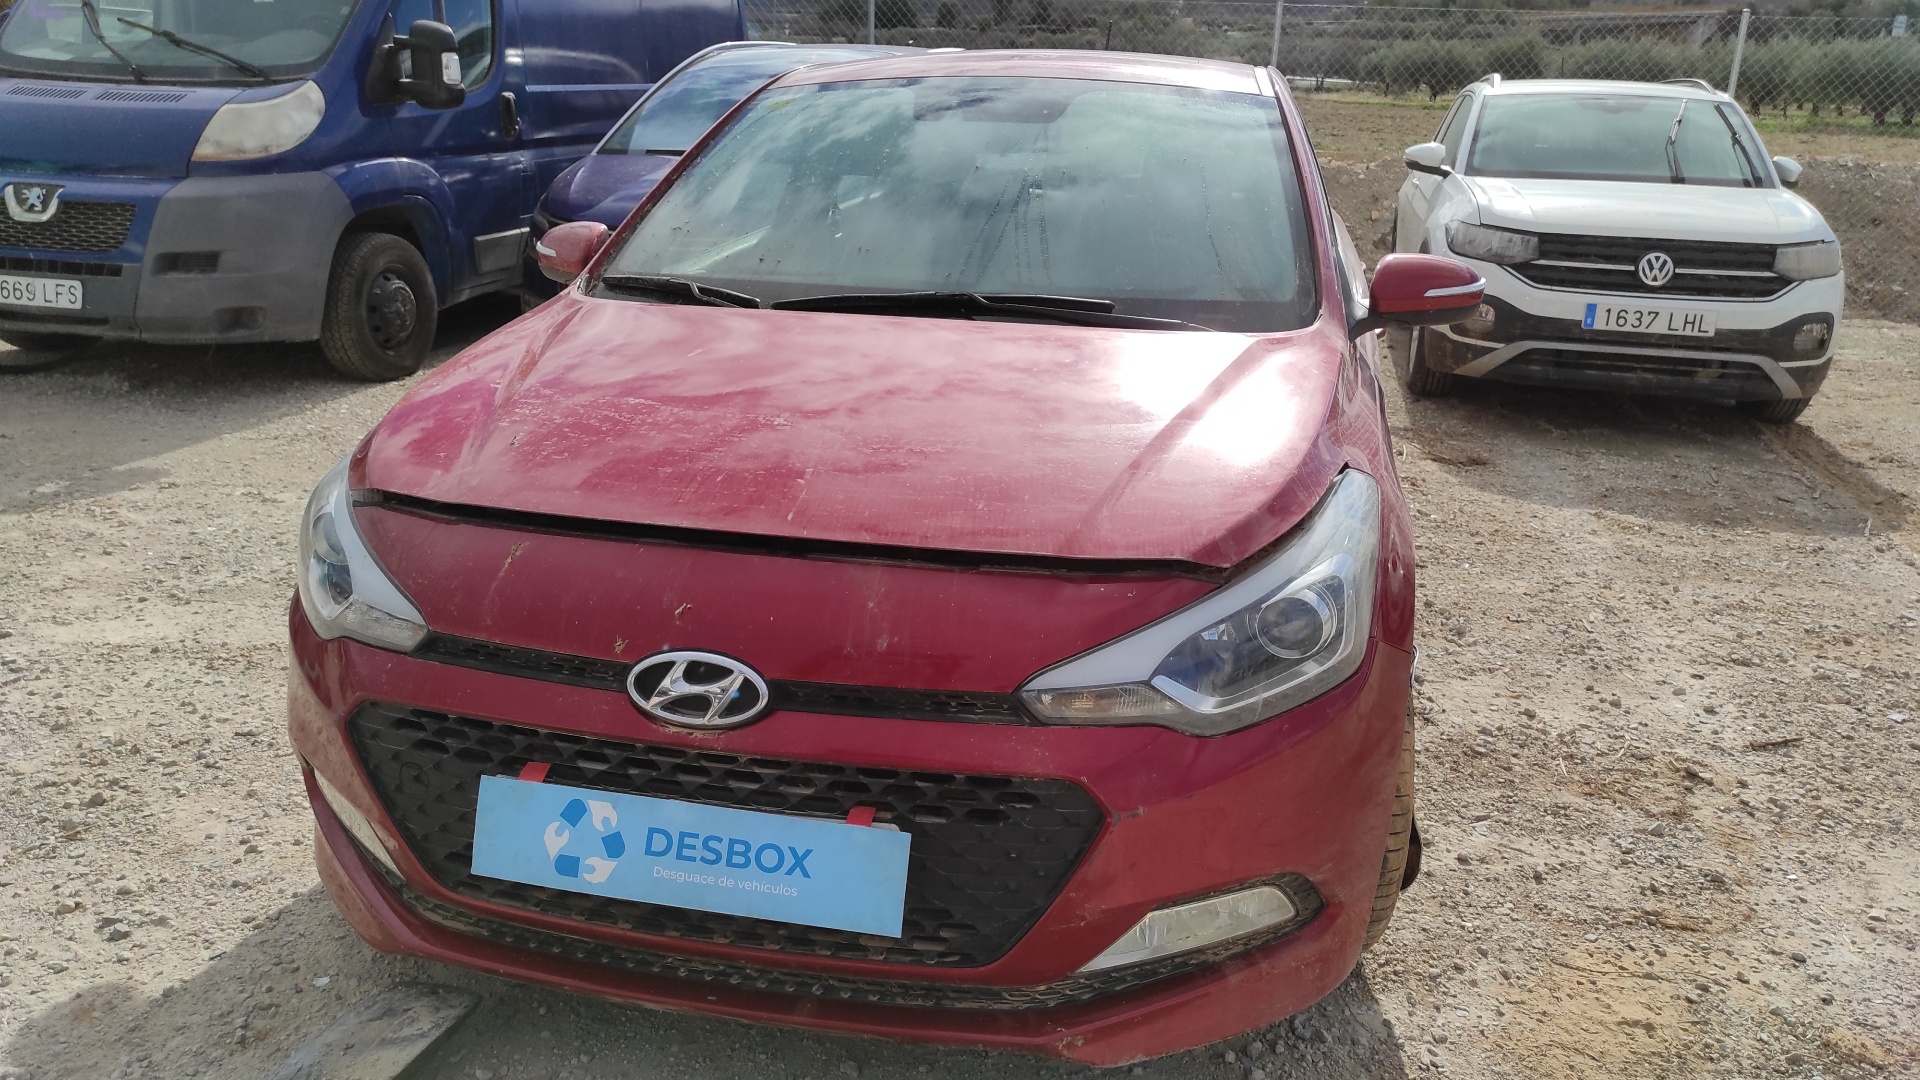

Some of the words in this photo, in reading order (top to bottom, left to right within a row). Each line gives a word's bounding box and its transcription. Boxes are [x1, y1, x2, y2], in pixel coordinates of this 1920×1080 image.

[43, 282, 78, 305] LFS
[1604, 307, 1660, 330] 1637
[1667, 312, 1710, 334] LHL
[644, 826, 814, 879] DESBOX
[653, 866, 715, 885] Desguace
[718, 875, 735, 888] de
[737, 879, 798, 897] vehículos
